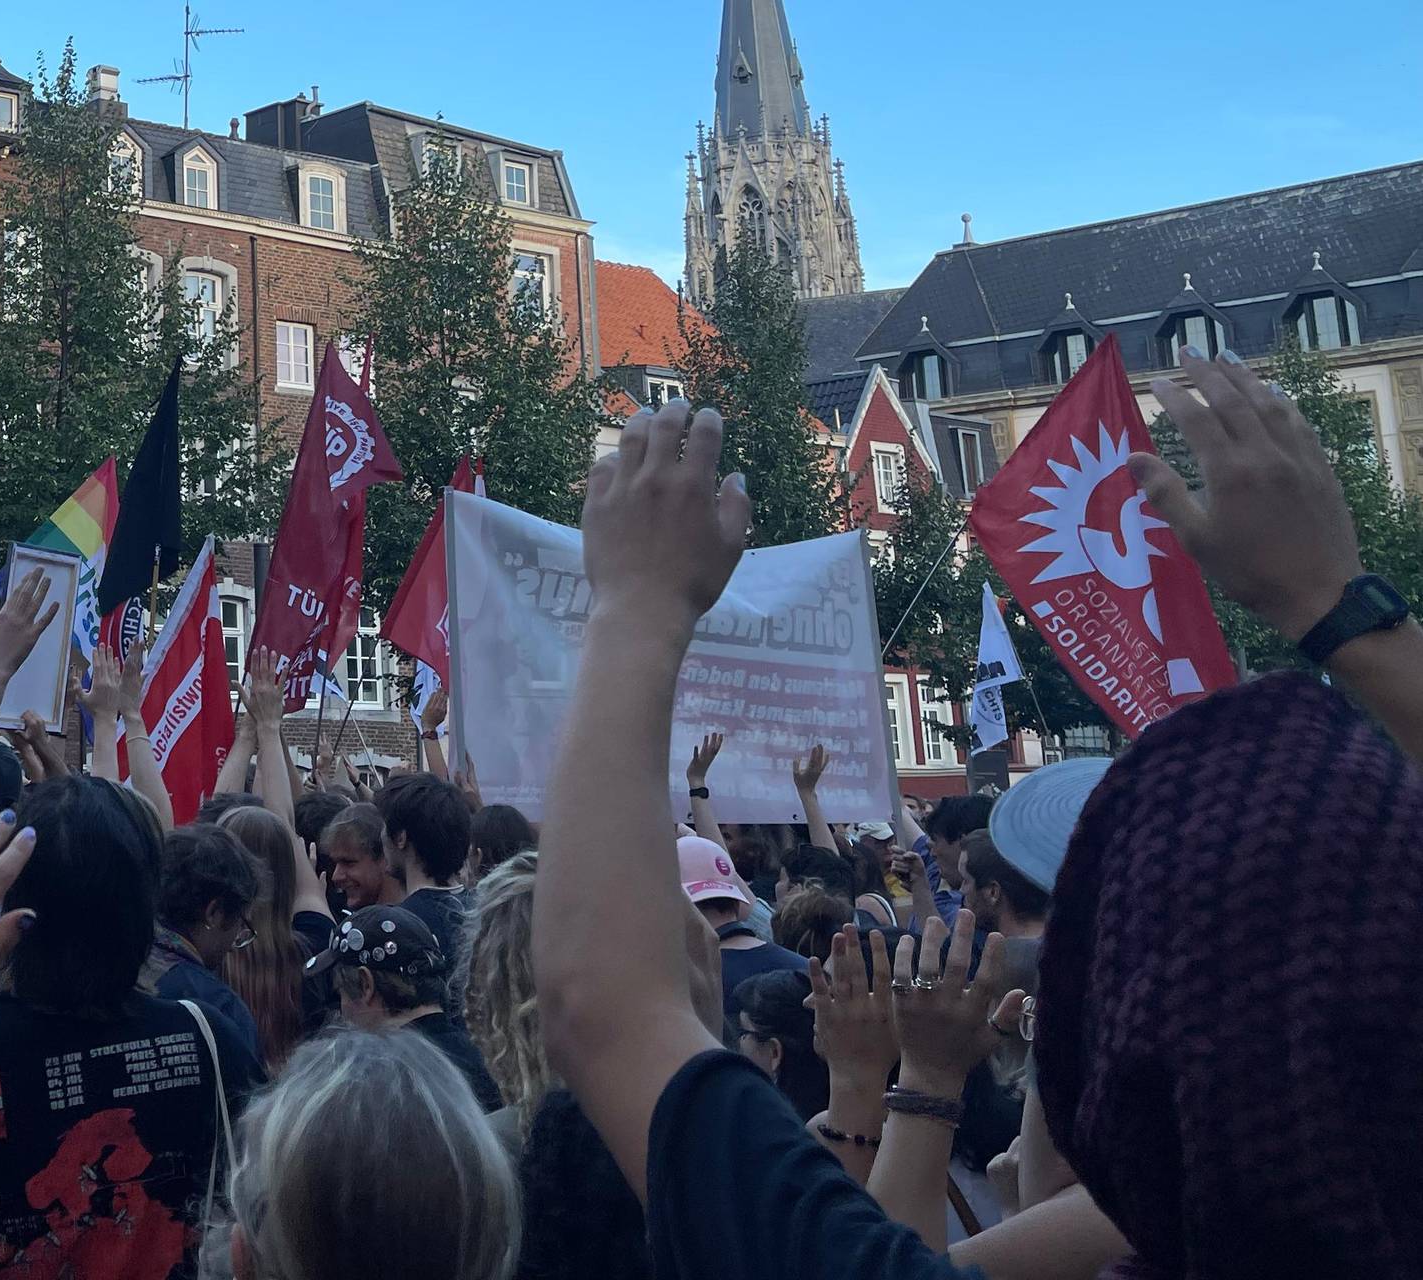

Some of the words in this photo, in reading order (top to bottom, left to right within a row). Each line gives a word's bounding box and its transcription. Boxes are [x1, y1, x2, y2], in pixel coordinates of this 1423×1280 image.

[1054, 588, 1172, 720] ORGANISATIO
[1044, 615, 1152, 732] SOLIDARIT
[155, 1032, 195, 1046] SWEDEN
[160, 1043, 197, 1055] FRANCE
[161, 1053, 198, 1067] FRANCE
[174, 1065, 199, 1076] ITALY
[155, 1076, 201, 1091] GERMANY
